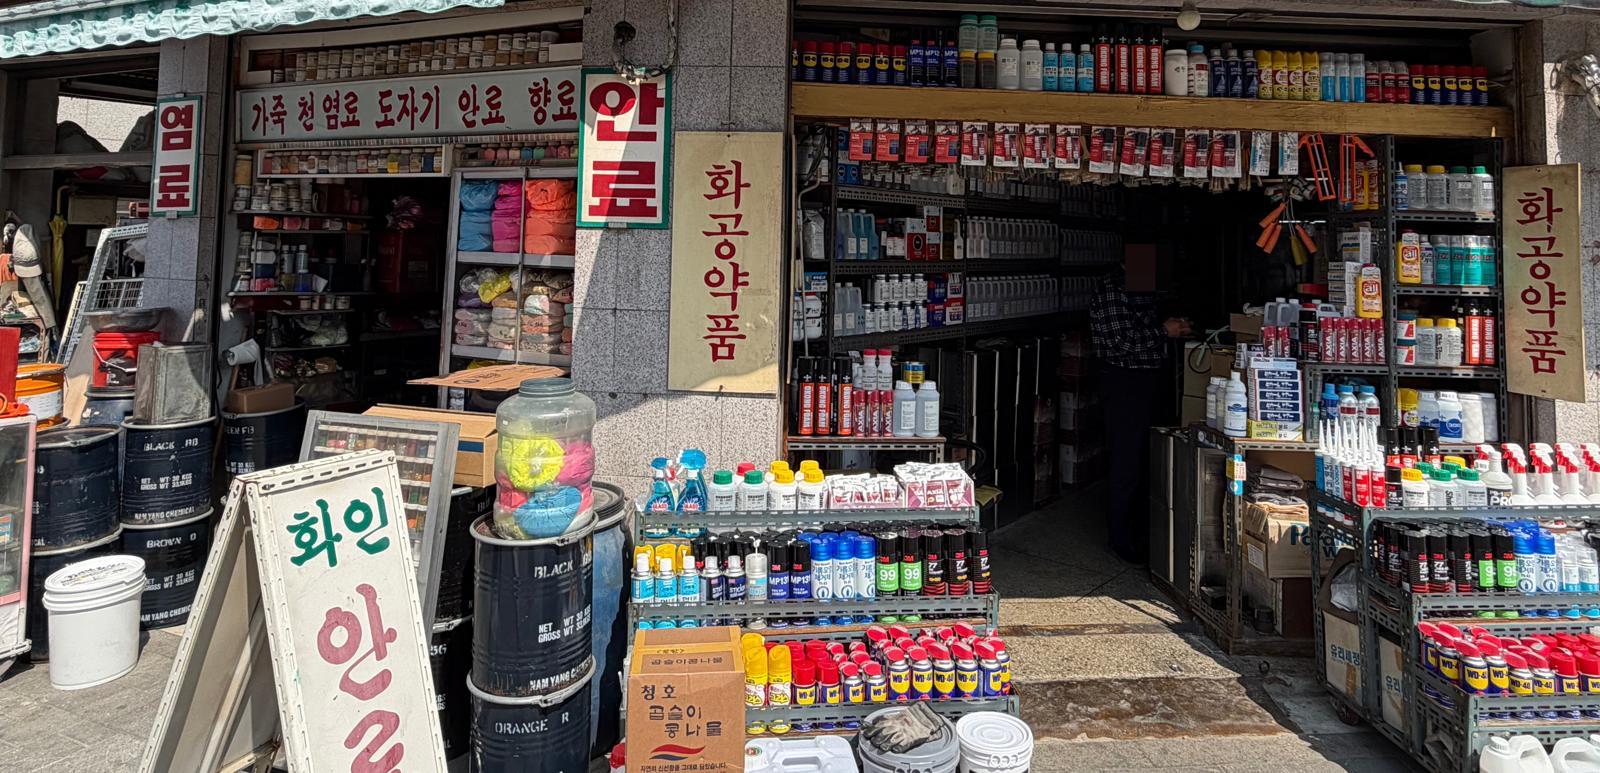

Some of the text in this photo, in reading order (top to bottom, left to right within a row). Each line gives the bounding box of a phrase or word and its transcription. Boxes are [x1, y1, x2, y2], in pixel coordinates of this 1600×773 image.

[252, 95, 288, 137] 가죽
[322, 89, 361, 131] 염료
[375, 86, 441, 131] 도자기
[458, 83, 506, 128] 안료
[527, 77, 578, 126] 향료
[157, 104, 194, 208] 염료
[589, 81, 665, 218] 안료
[702, 159, 751, 363] 화공약품
[1516, 187, 1567, 374] 화공약품
[286, 486, 391, 568] 화인
[146, 537, 182, 549] BROWN
[534, 560, 573, 578] BLACK
[880, 569, 896, 581] 99
[904, 568, 920, 580] 99
[141, 614, 150, 622] AM
[169, 604, 192, 617] CHEMIC
[538, 622, 553, 633] NET
[563, 615, 574, 627] WT
[538, 625, 574, 643] GROSS WT
[530, 678, 549, 691] NAM
[550, 670, 570, 687] YANG
[649, 704, 702, 720] 곱슬이
[495, 712, 569, 735] ORANGE R
[664, 721, 722, 739] 콩나물
[681, 763, 698, 771] 그대로
